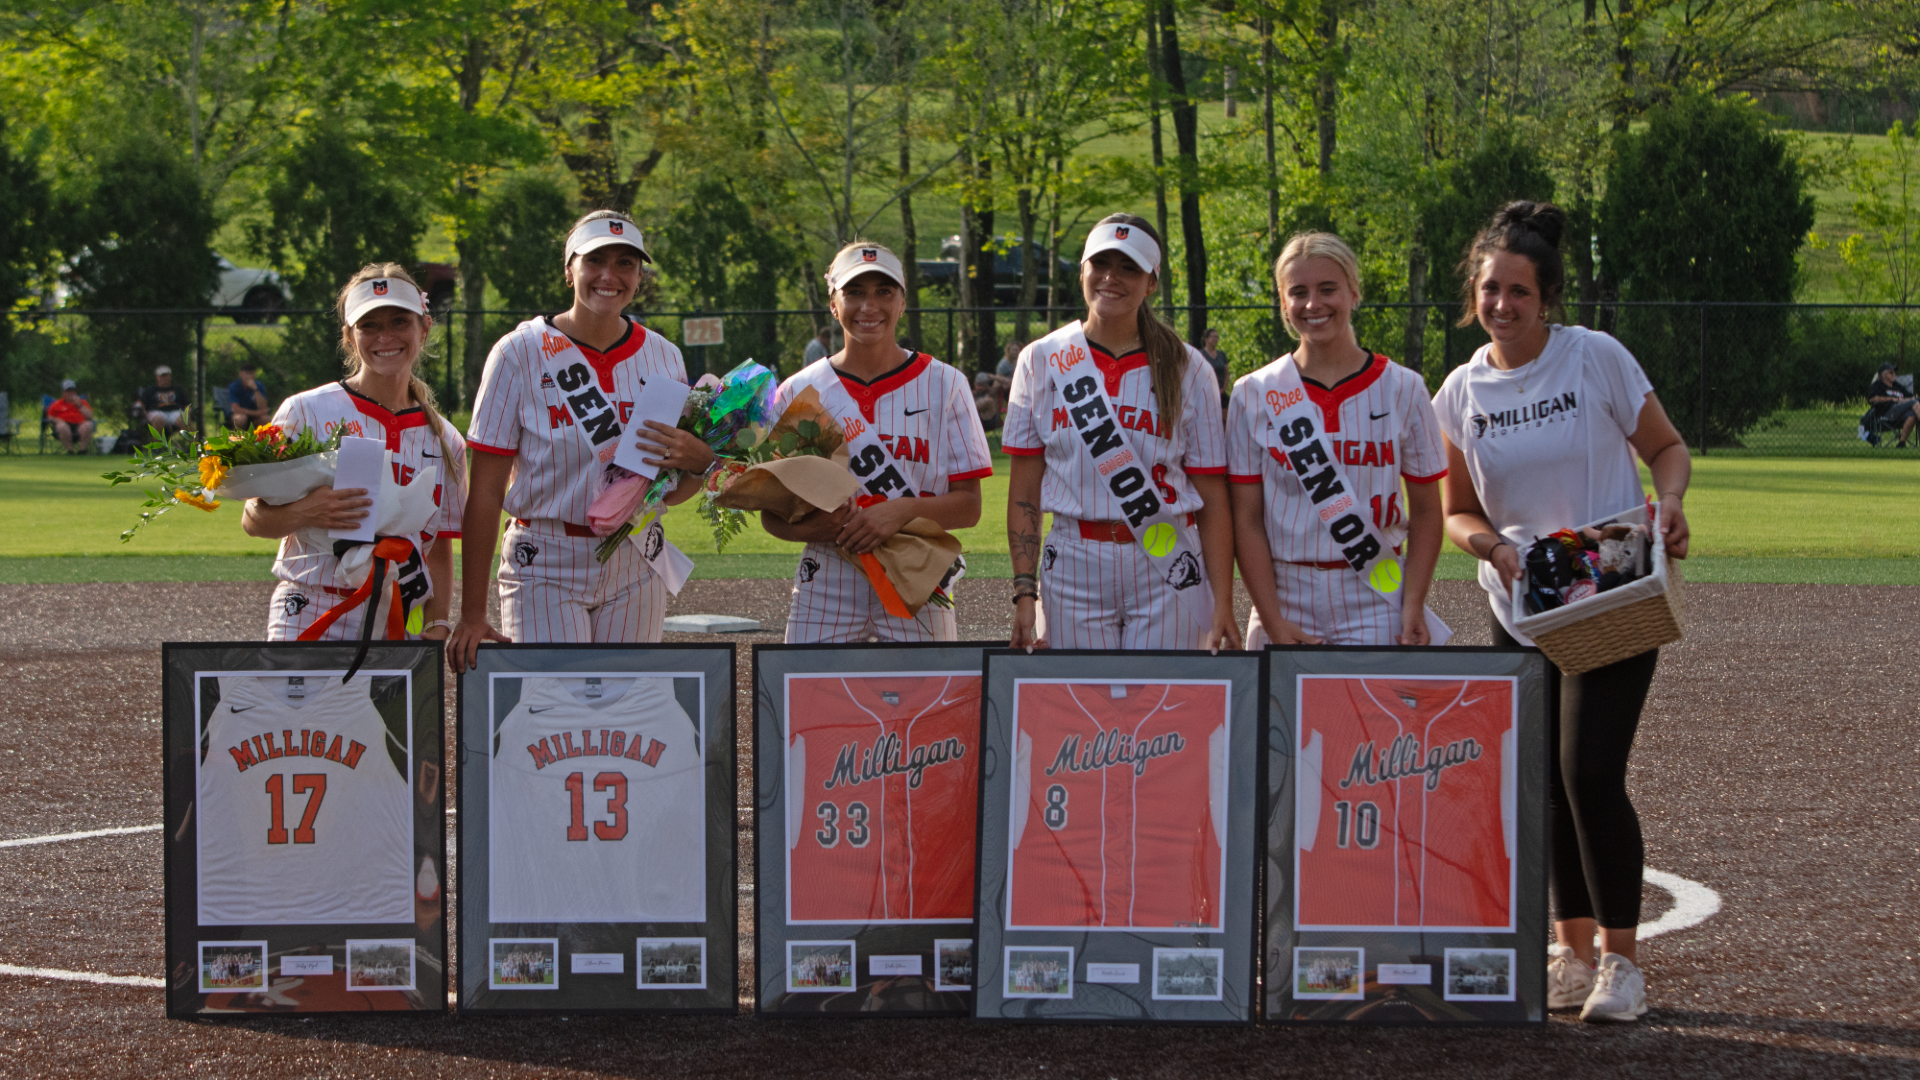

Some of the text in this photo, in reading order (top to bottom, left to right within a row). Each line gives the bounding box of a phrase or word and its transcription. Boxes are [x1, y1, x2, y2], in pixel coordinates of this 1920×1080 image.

[687, 320, 720, 343] 225
[1050, 344, 1086, 375] Kate
[1265, 387, 1304, 416] Bree
[1489, 391, 1577, 430] MILLIGAN
[1490, 411, 1578, 439] SOFTBALL
[228, 729, 367, 773] MILLIGAN
[526, 729, 667, 771] MILLIGAN
[824, 731, 966, 790] Milligan
[1338, 732, 1483, 792] Milligan
[265, 773, 327, 845] 17
[564, 771, 629, 842] 13
[815, 801, 870, 848] 33
[1044, 783, 1068, 831] 8
[1334, 801, 1381, 849] 10
